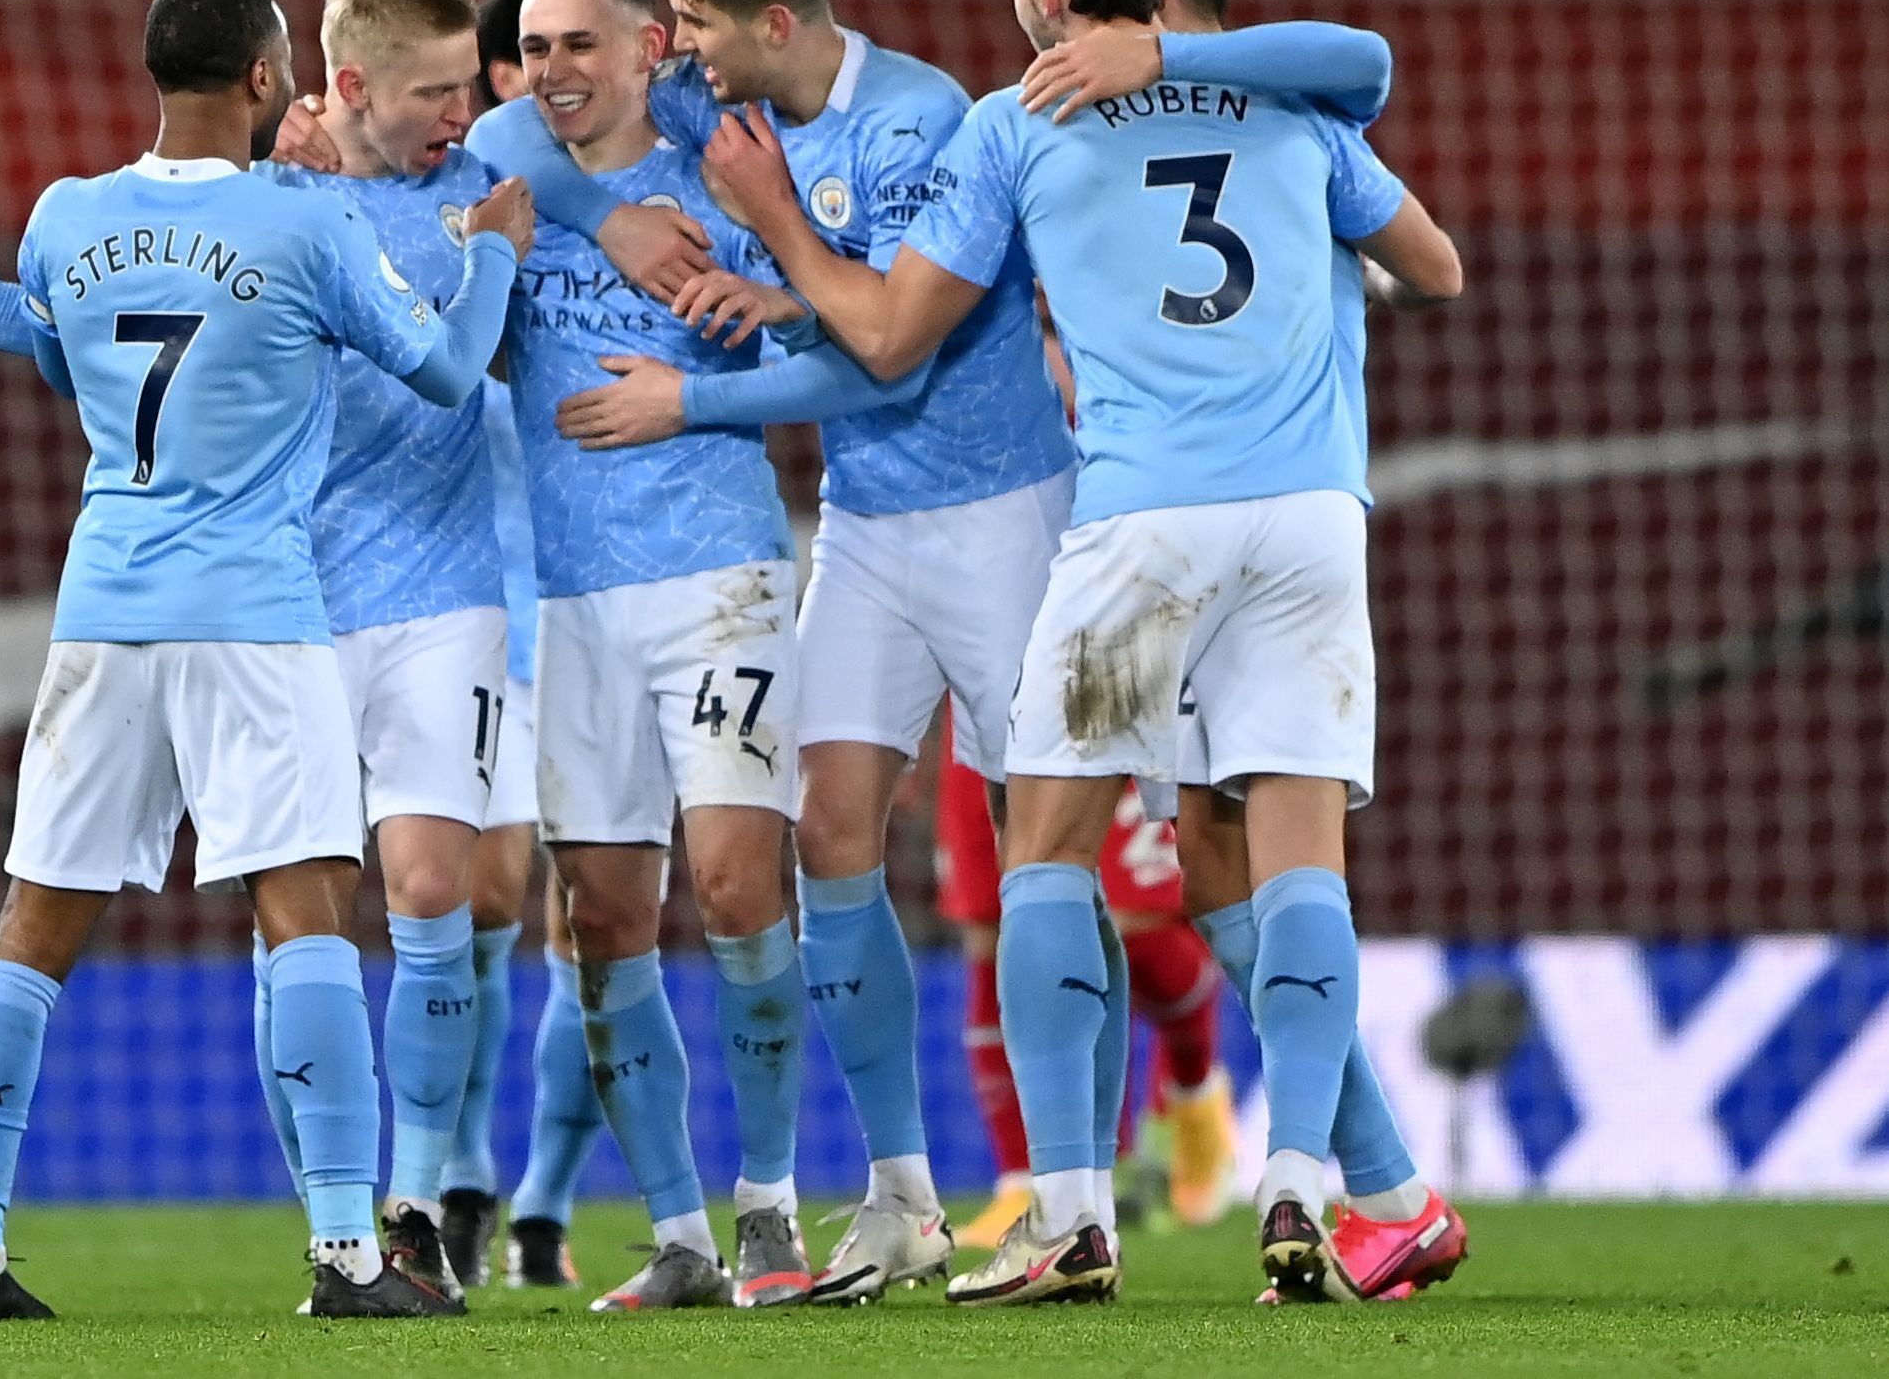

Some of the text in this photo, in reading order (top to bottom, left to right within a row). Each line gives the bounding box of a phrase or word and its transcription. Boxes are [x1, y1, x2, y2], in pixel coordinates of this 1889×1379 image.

[65, 226, 266, 303] STERLING
[1141, 149, 1255, 328] 3
[113, 311, 207, 487] 7
[691, 666, 776, 738] 47
[426, 995, 473, 1017] CITY
